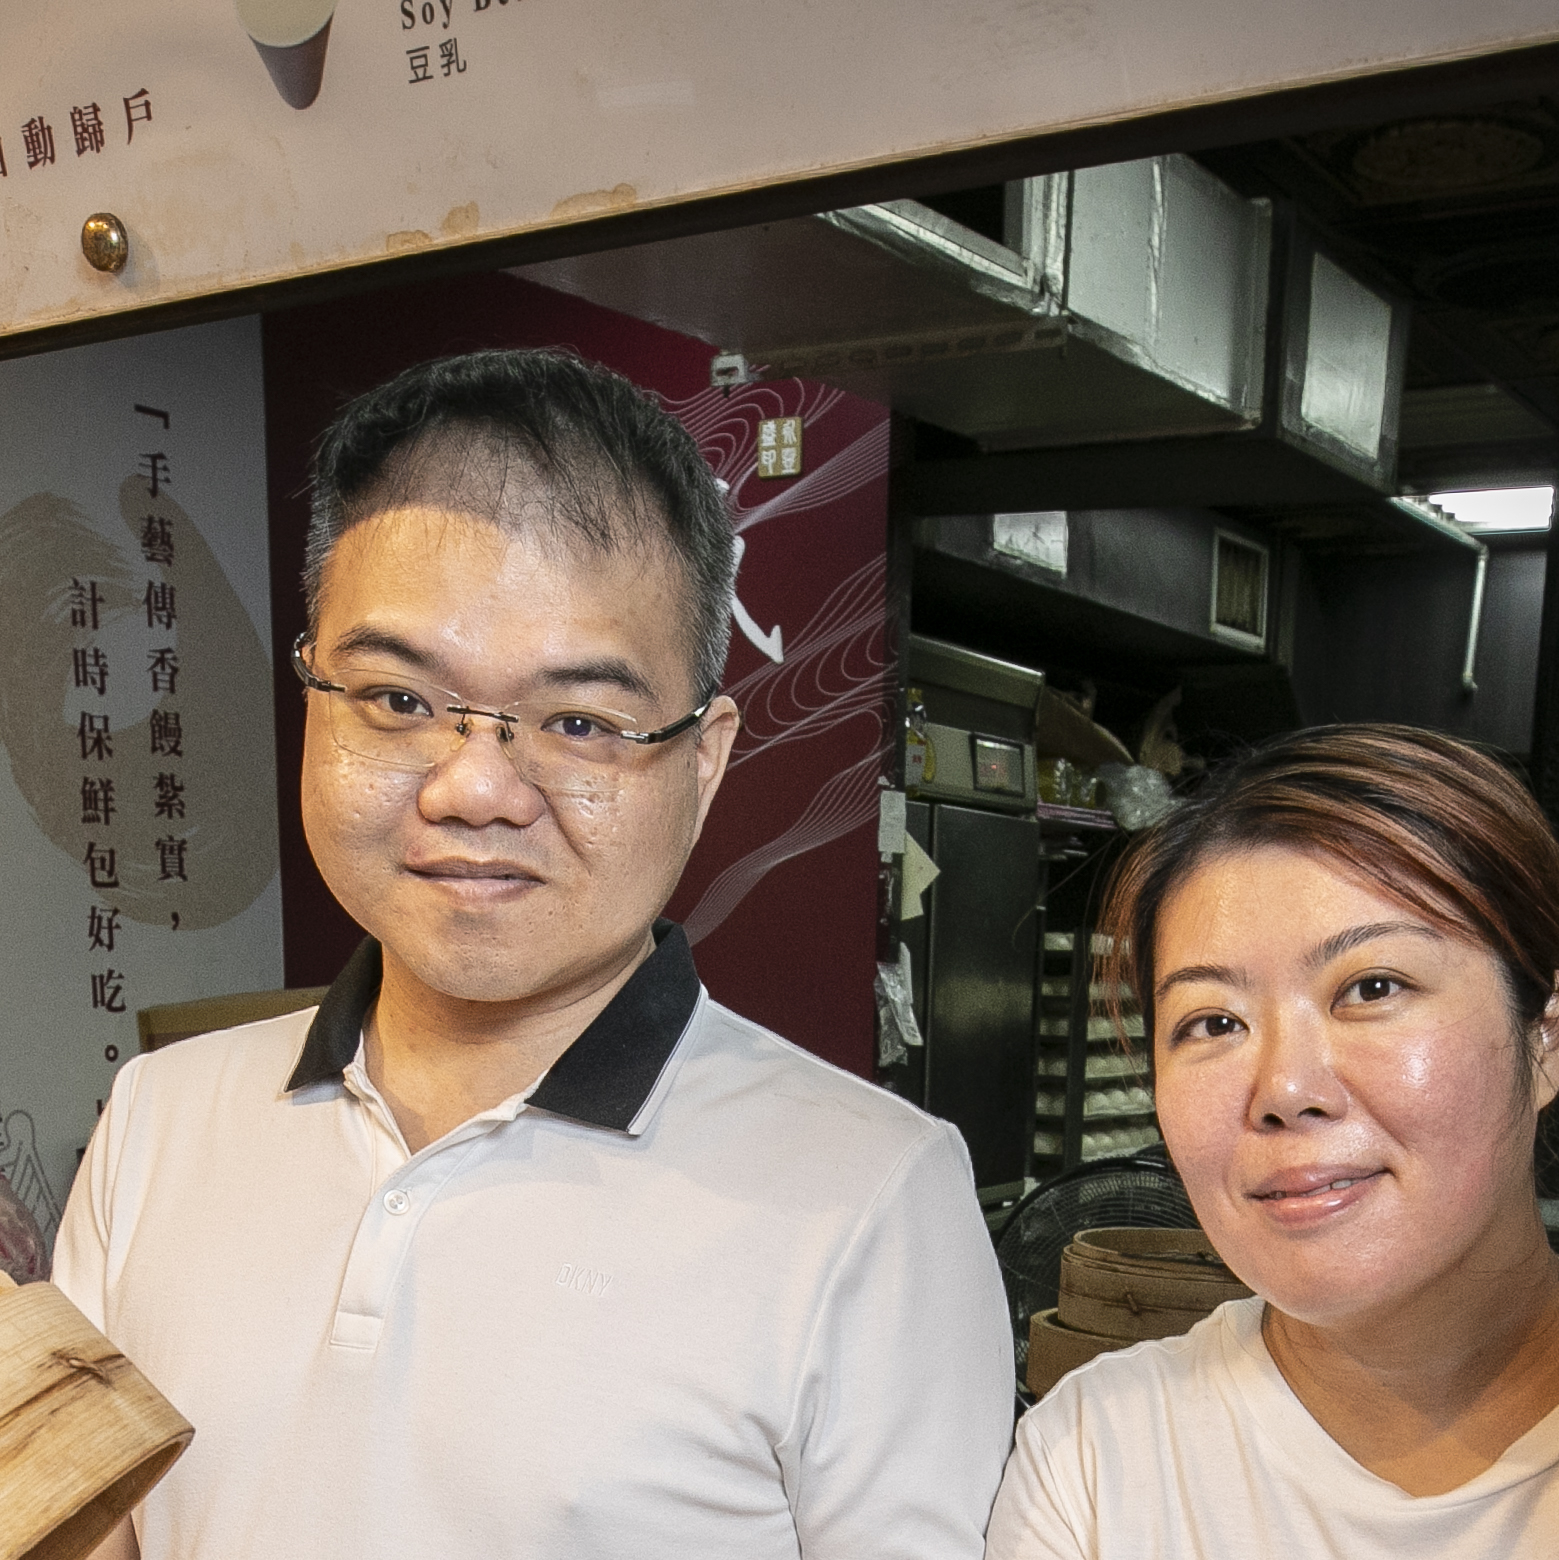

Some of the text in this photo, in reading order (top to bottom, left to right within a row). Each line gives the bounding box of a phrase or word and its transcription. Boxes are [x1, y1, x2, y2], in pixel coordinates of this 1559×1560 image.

[399, 0, 451, 30] Soy
[405, 37, 468, 84] 豆乳
[133, 403, 190, 932] 「手藝傳香饅紮實，
[68, 578, 128, 1117] 計時保鮮包好吃。
